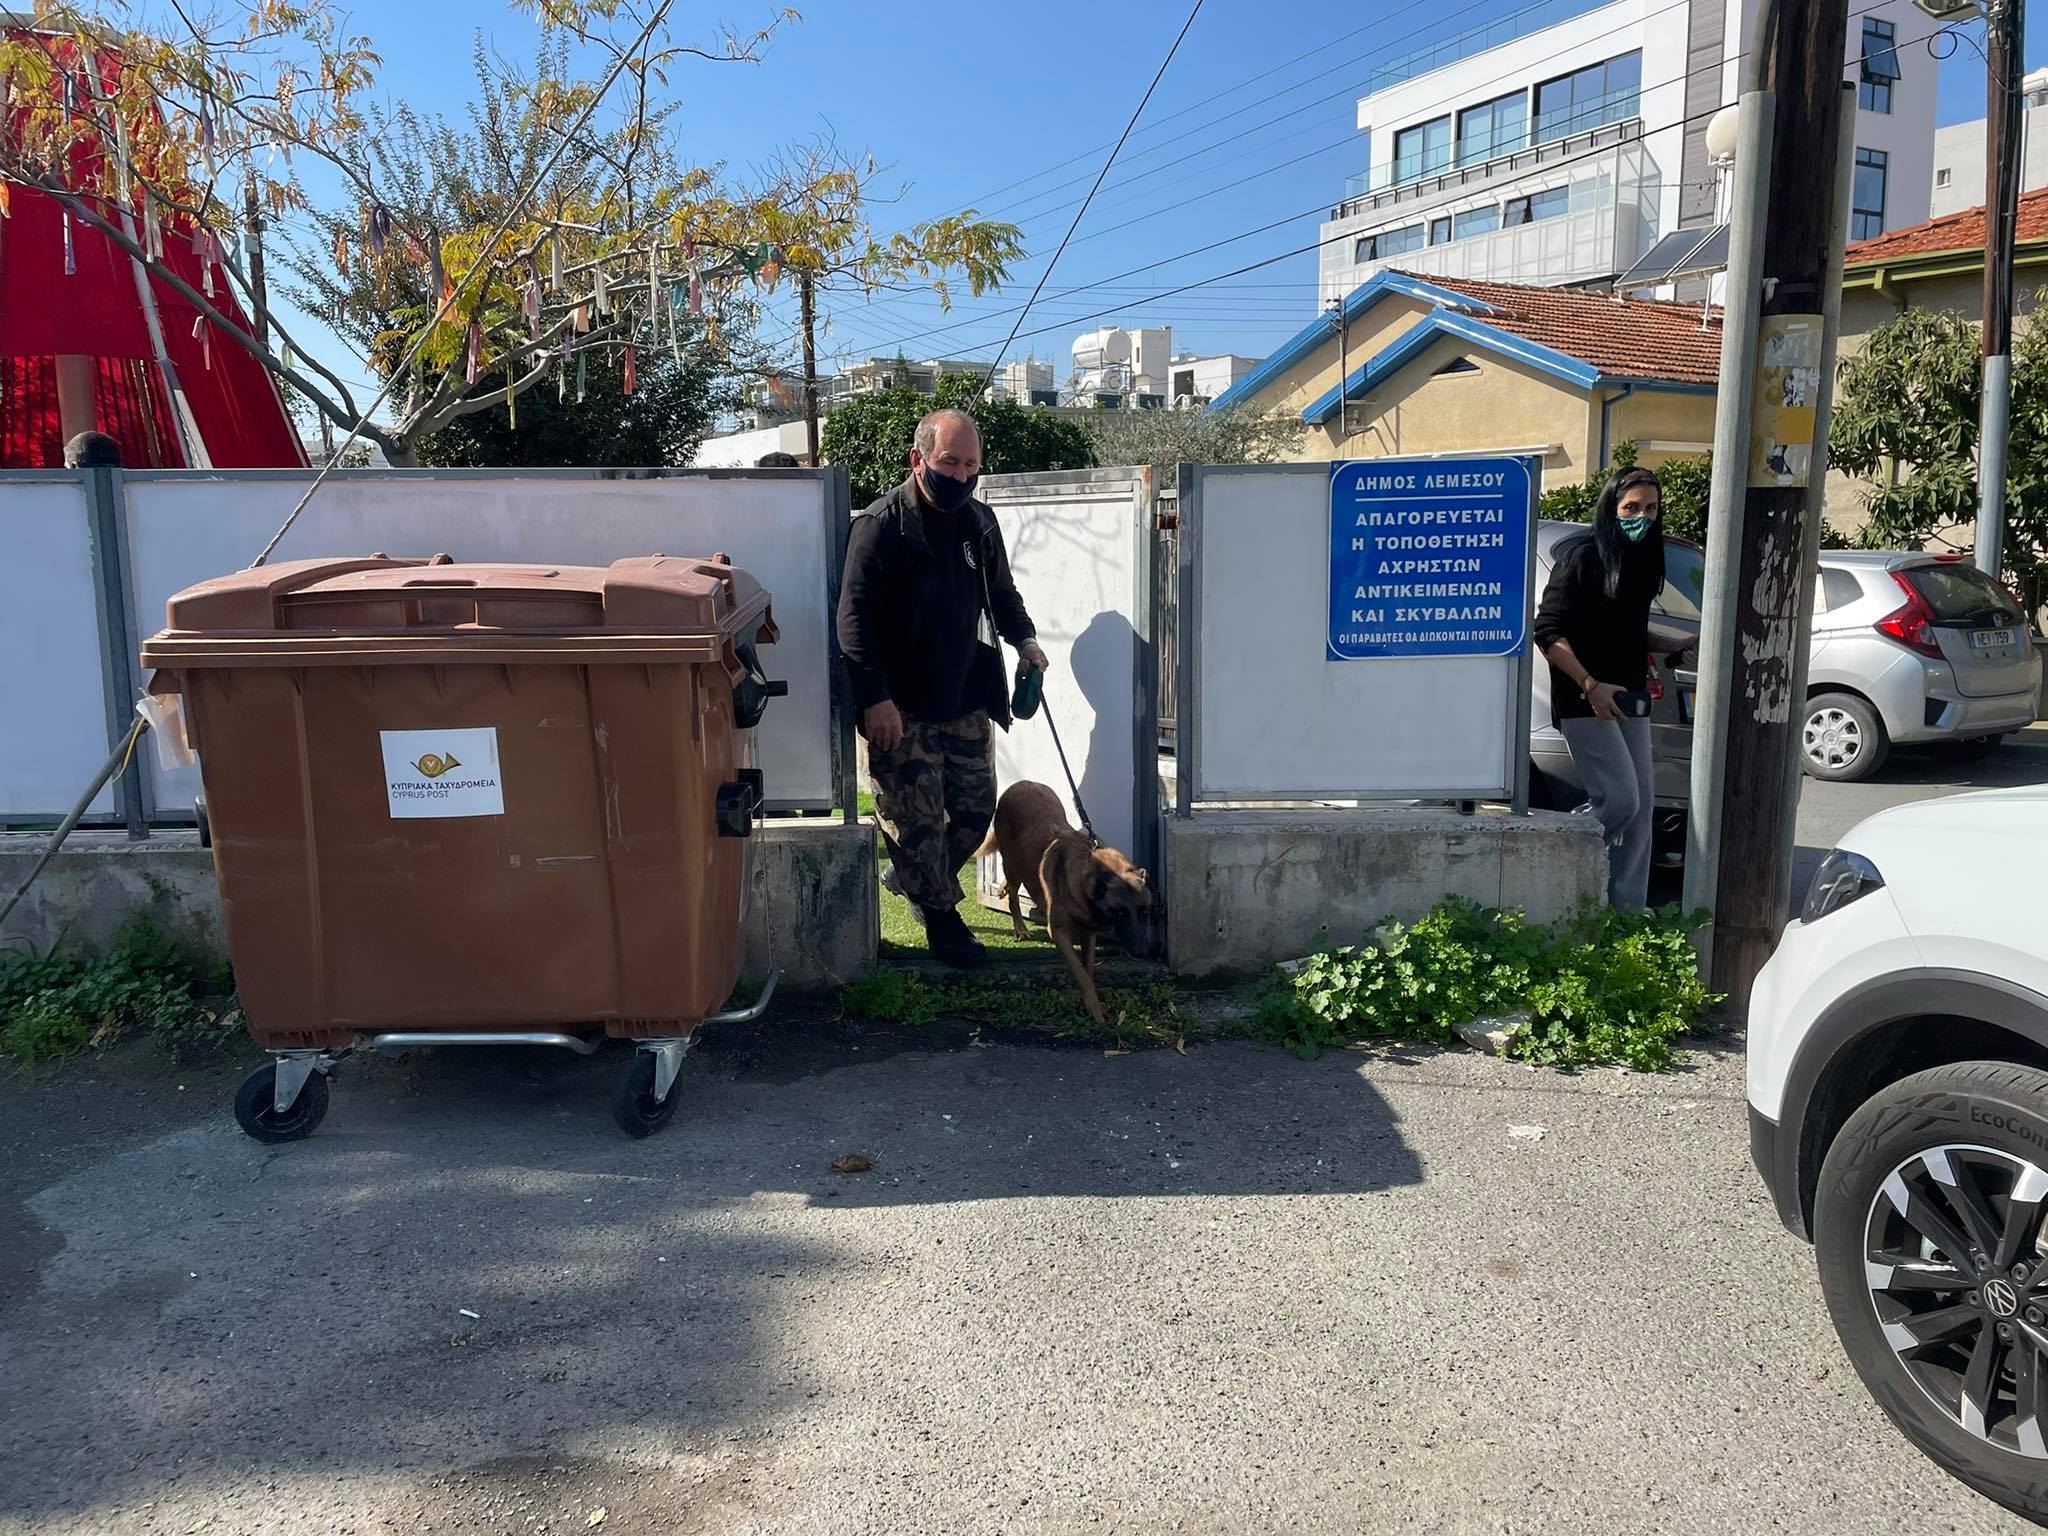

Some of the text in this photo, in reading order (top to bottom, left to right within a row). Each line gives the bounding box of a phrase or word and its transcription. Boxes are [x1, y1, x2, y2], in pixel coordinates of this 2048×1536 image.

[1355, 473, 1505, 491] ΔΗΜΟΣ ΛΕΜΕΣΟΥ
[1355, 509, 1503, 526] ΑΠΑΓΟΡΕΥΕΤΑΙ
[1352, 534, 1504, 551] Η ΤΟΠΟΘΕΤΗΣΗ
[1378, 559, 1481, 574] ΑΧΡΗΣΤΩΝ
[1354, 582, 1501, 598] ΑΝΤΙΚΕΙΜΕΝΩΝ
[1352, 606, 1501, 623] ΚΑΙ ΣΚΥΒΑΛΩΝ
[1339, 630, 1513, 644] ΟΙ ΠΑΡΑΒΑΤΕΣ ΘΑ ΔΙΩΚΟΝΤΑΙ ΠΟΙΝΙΚΑ
[391, 779, 496, 791] ΚΥΠΡΙΑΚΑ ΤΑΧΥΔΡΟΜΕΙΑ
[392, 790, 449, 799] CYPRUS POST
